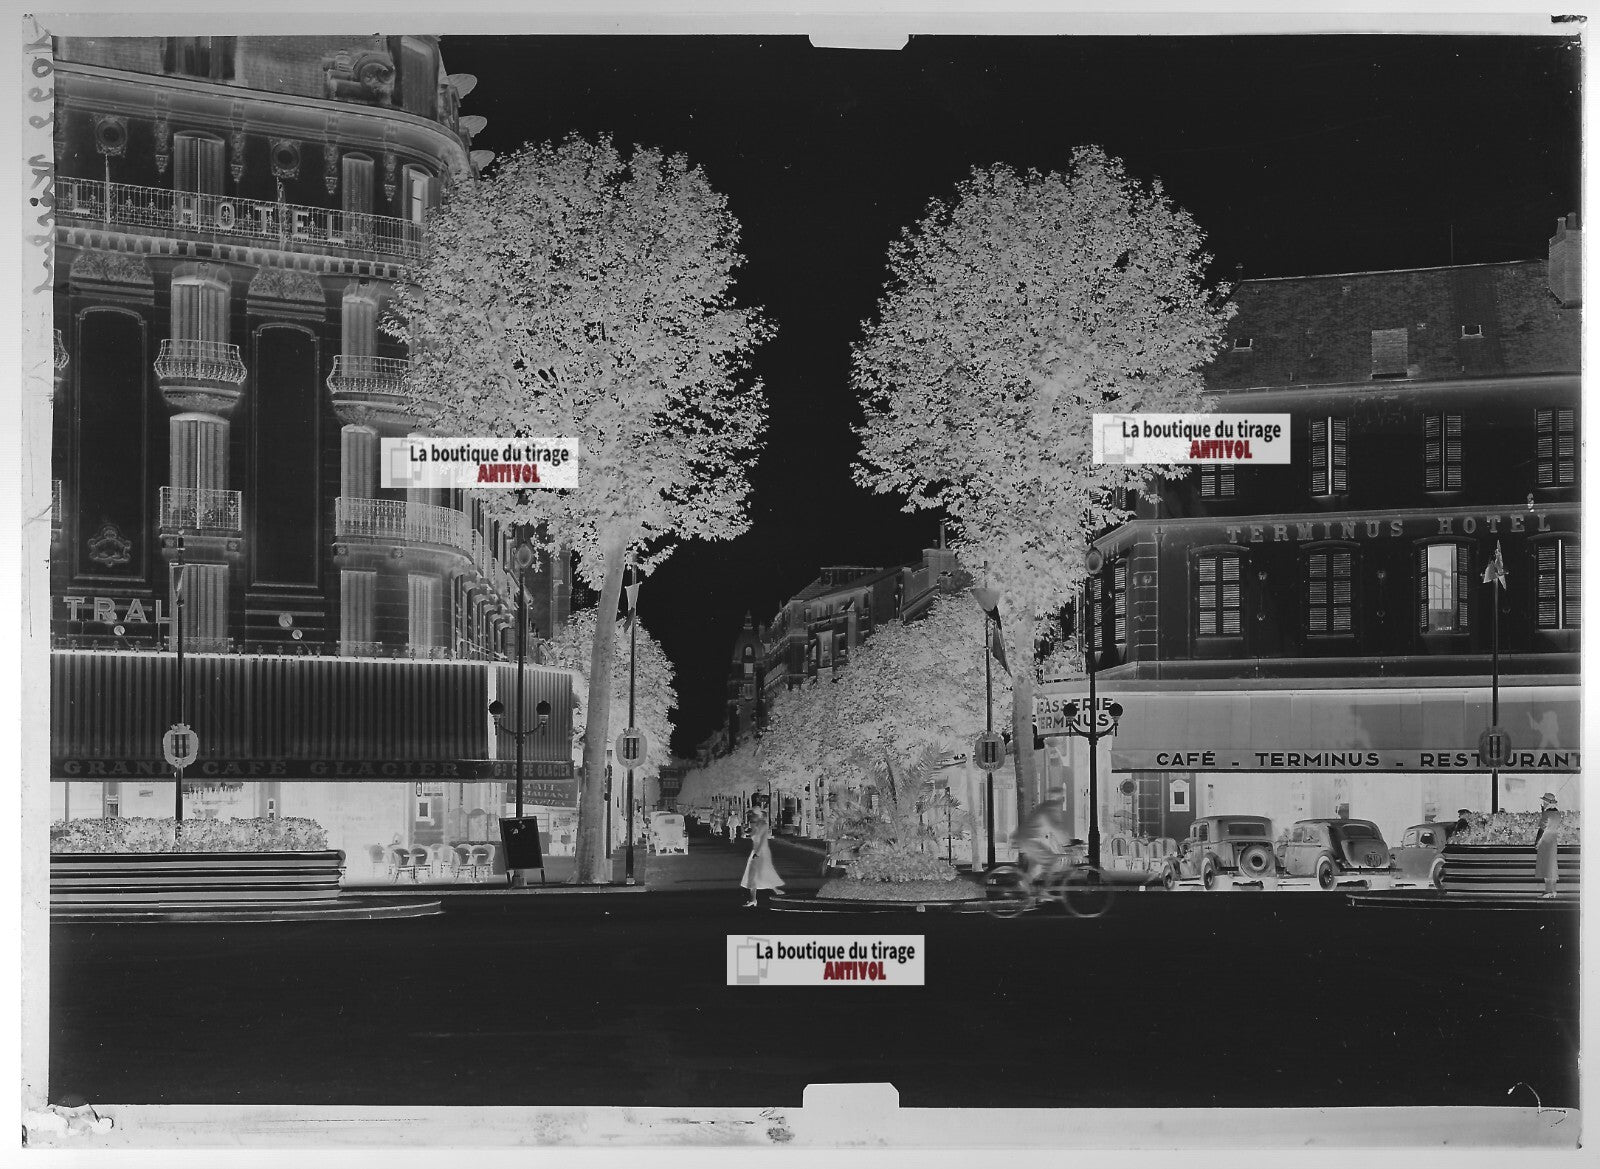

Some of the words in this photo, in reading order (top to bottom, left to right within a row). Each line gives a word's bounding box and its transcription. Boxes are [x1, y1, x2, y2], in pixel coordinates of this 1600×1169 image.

[176, 197, 347, 243] HOTEL
[1226, 518, 1404, 545] TERMINUS
[1437, 513, 1551, 536] HOTEL
[309, 761, 460, 777] GLACIER
[1156, 749, 1216, 767] CAFÉ
[1255, 752, 1380, 767] TERMINUS
[1419, 752, 1581, 768] RESTURANT
